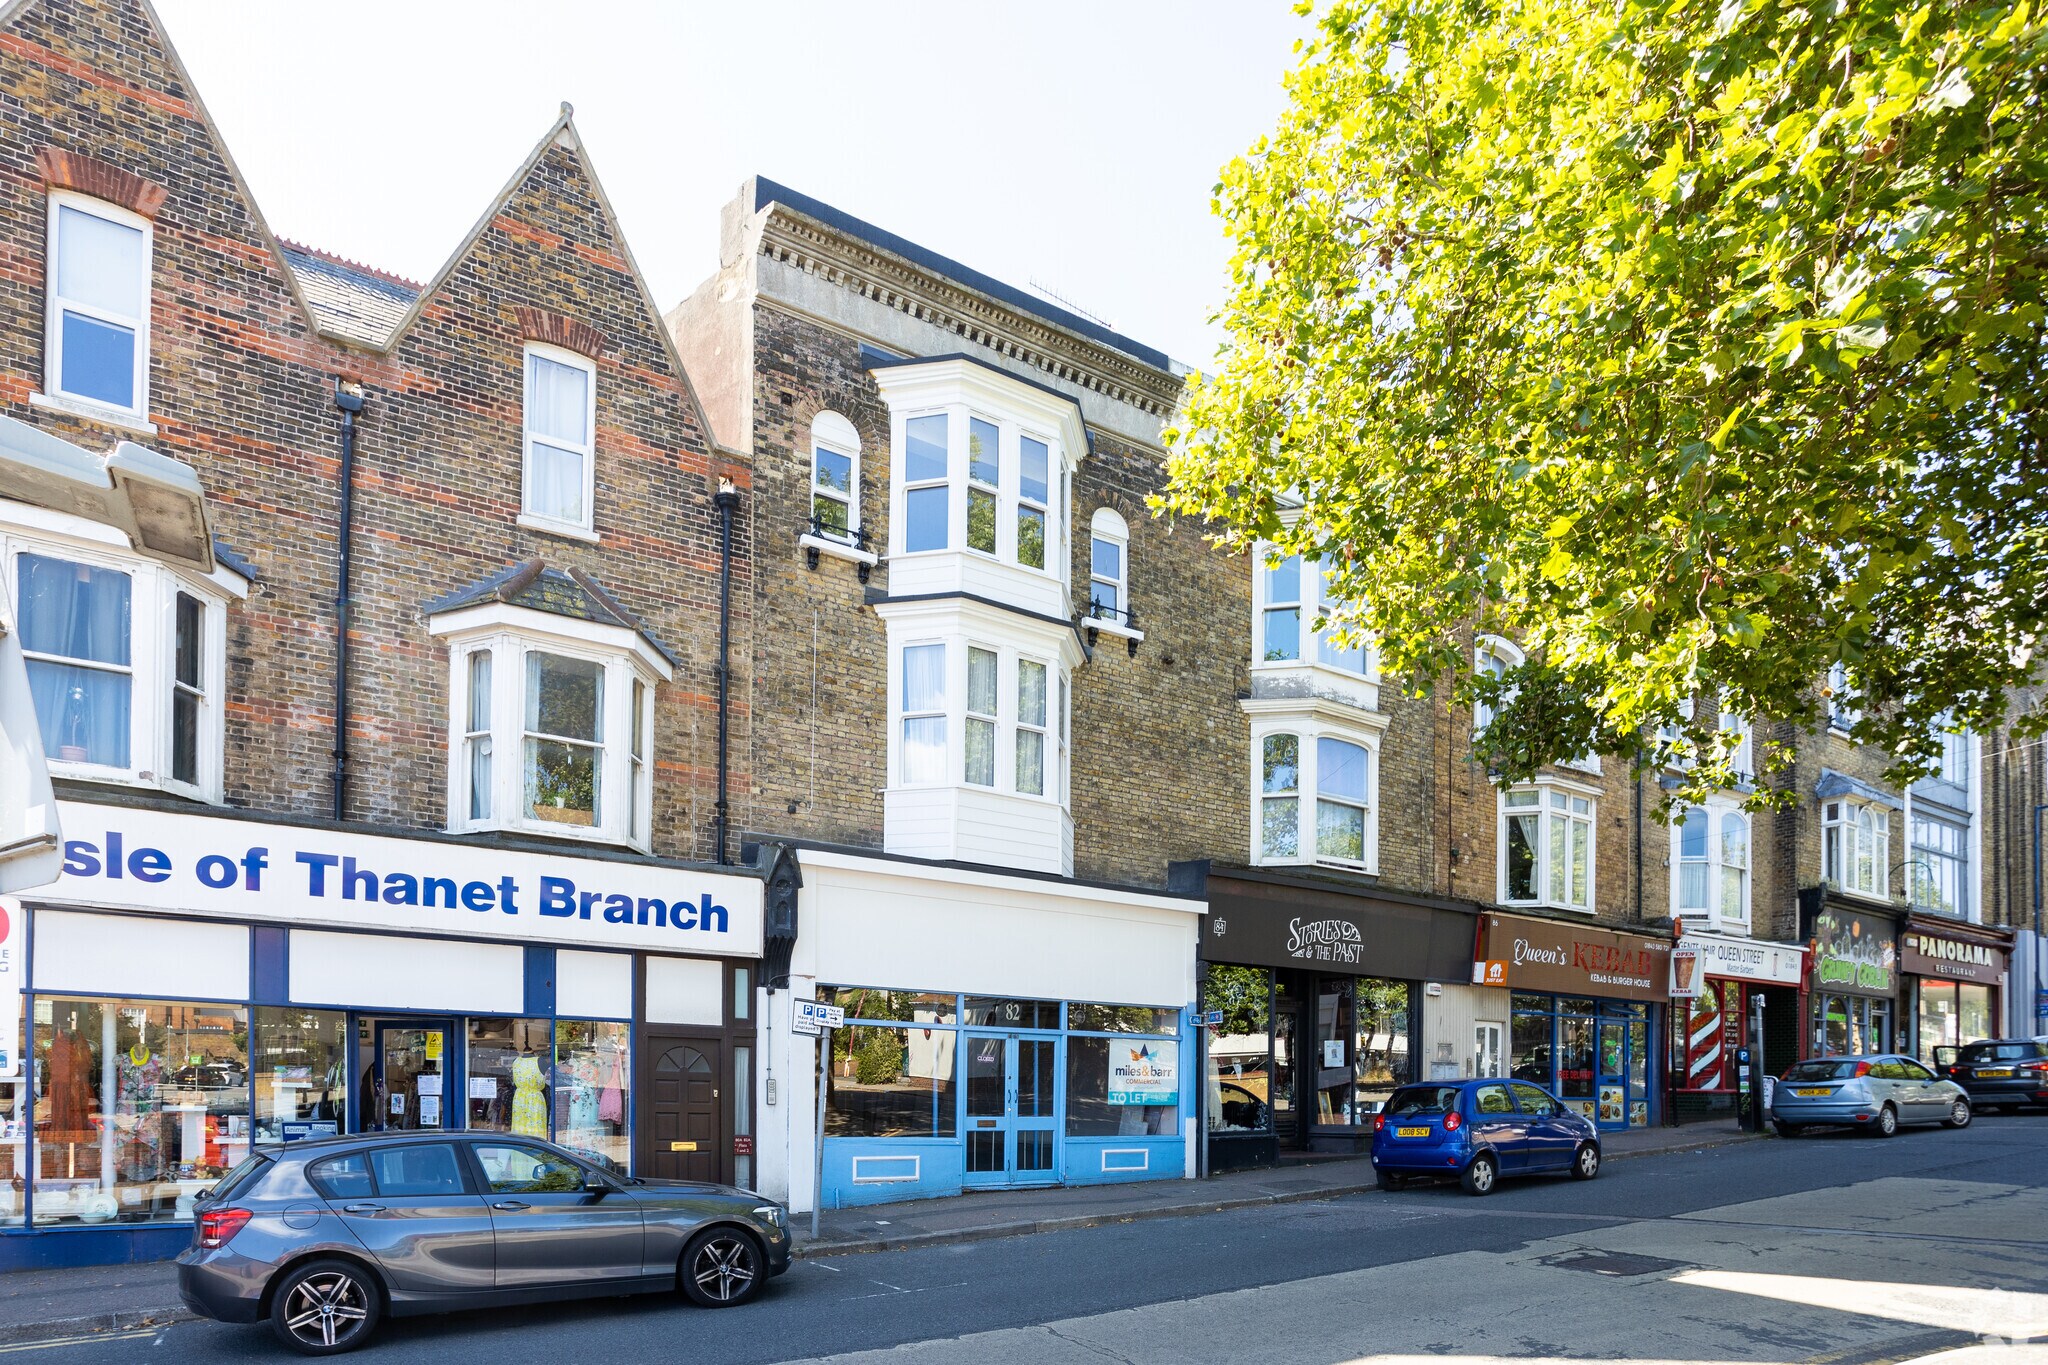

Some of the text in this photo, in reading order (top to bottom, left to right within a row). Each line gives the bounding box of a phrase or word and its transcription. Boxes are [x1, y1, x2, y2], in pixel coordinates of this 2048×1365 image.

[64, 831, 729, 933] sle of Thanet Branch
[1491, 919, 1499, 927] 86
[1287, 917, 1341, 951] STORIES
[1305, 940, 1364, 965] & THE PAST
[1572, 942, 1651, 976] KEBAB
[1717, 945, 1742, 963] QUEEN
[1742, 949, 1765, 965] STREET
[1919, 936, 1993, 967] PANORAMA
[1726, 963, 1740, 973] Master
[1935, 964, 1976, 977] RESTAURANT
[1590, 973, 1607, 984] KEBAB
[1612, 976, 1633, 986] BURGER
[1633, 978, 1651, 988] HOUSE
[1006, 1003, 1020, 1021] 82
[1112, 1093, 1127, 1104] TO
[1130, 1093, 1148, 1104] LET
